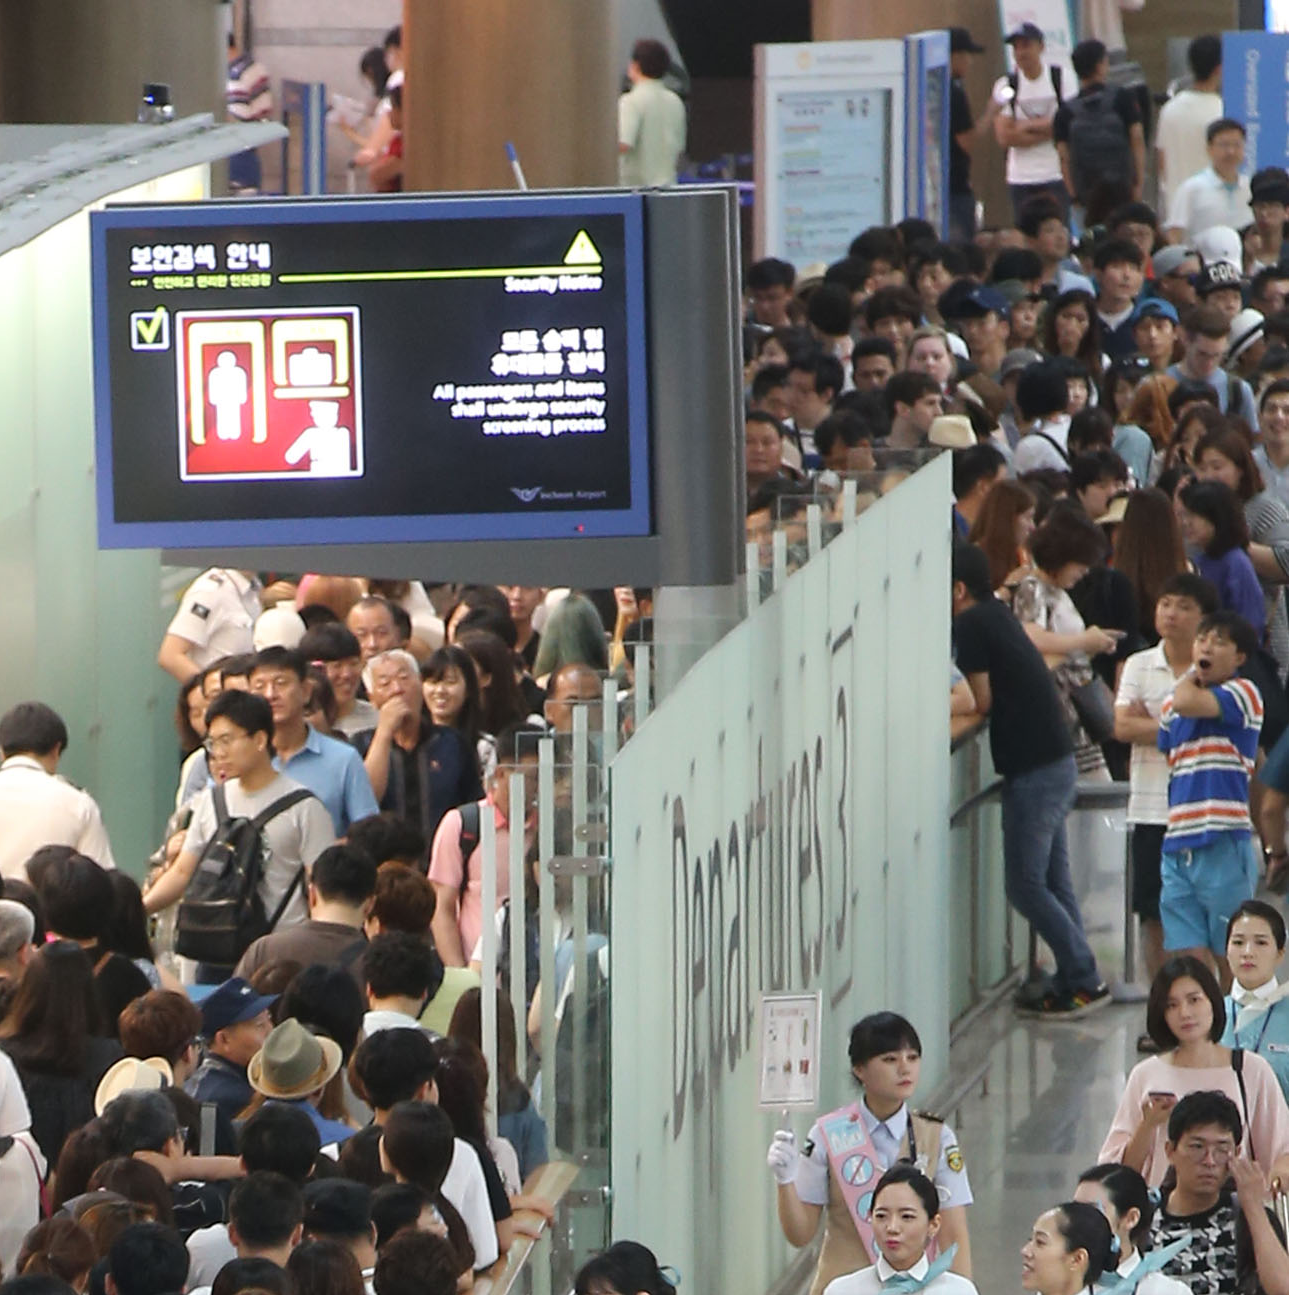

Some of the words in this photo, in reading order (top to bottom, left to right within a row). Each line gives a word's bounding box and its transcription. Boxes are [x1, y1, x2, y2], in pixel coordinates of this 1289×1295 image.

[130, 244, 216, 272] 보안검색
[226, 243, 271, 271] 안내
[504, 275, 558, 294] Security
[558, 275, 603, 291] Notice
[432, 383, 455, 401] All
[535, 380, 564, 398] and
[450, 399, 486, 418] shall
[549, 398, 606, 417] security
[672, 735, 824, 1185] Departures
[834, 684, 849, 953] 3
